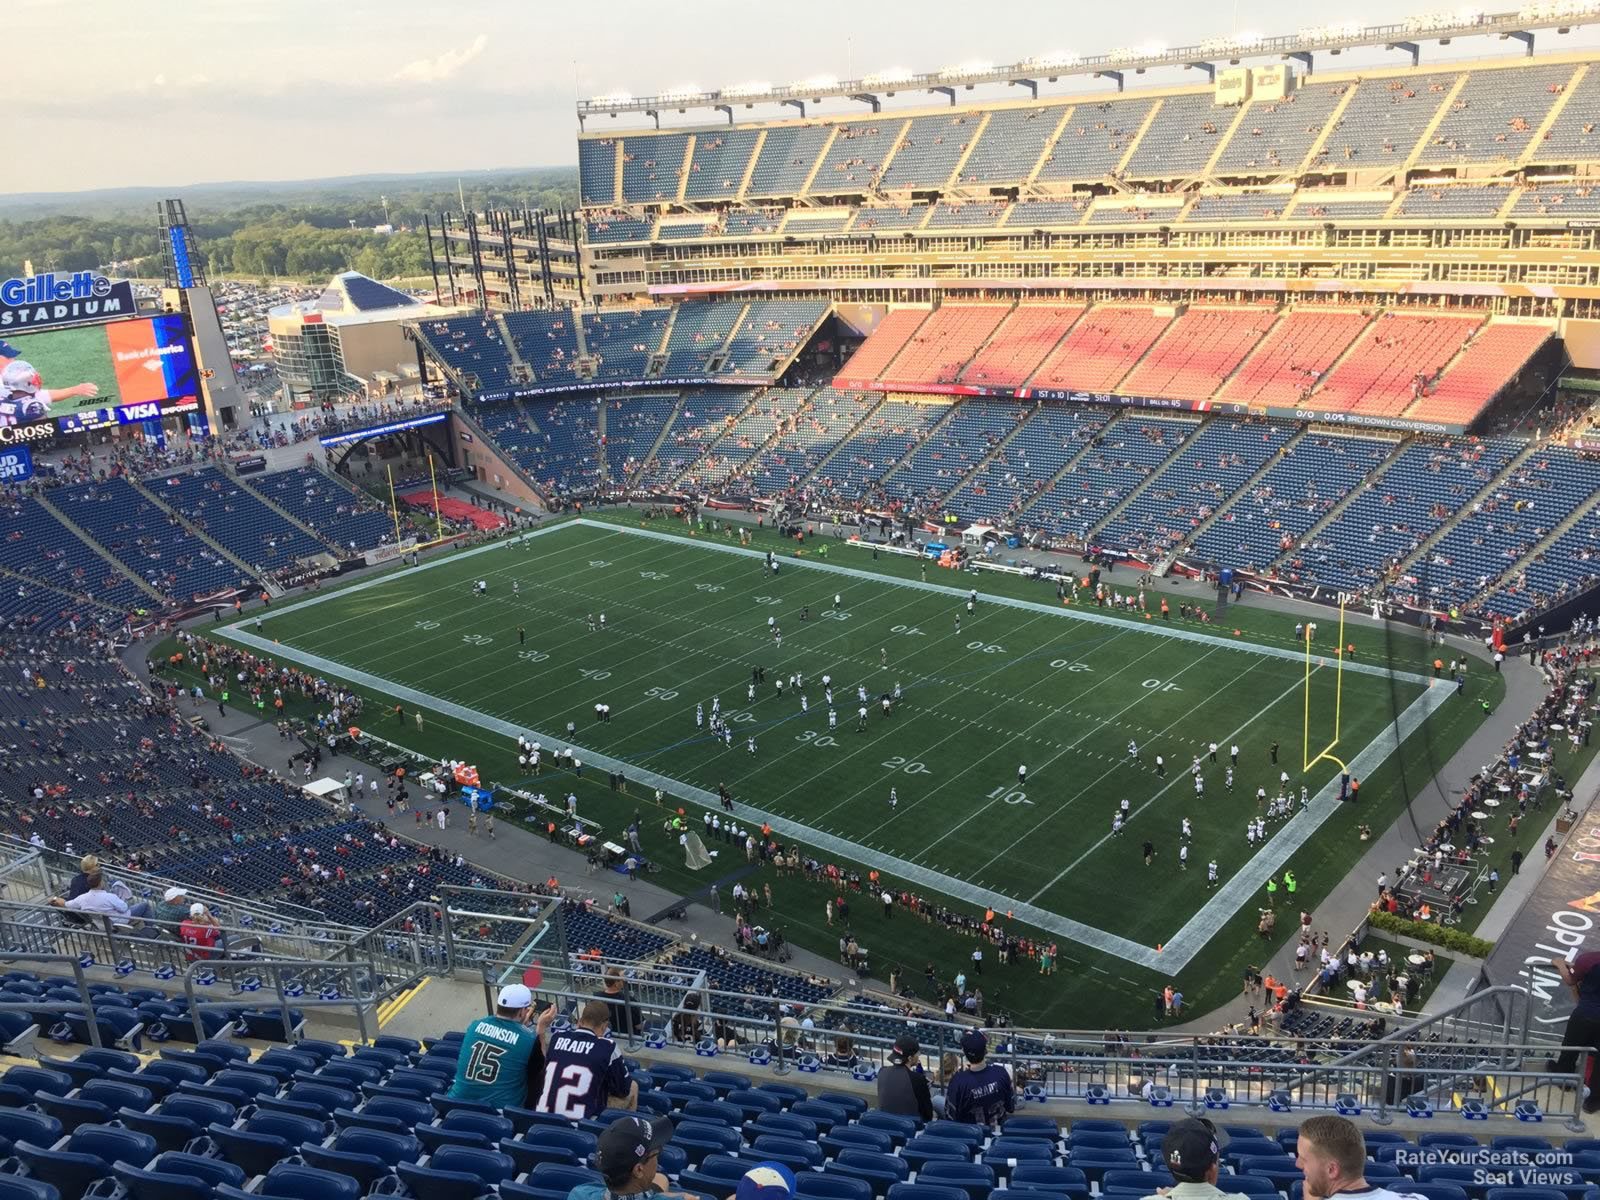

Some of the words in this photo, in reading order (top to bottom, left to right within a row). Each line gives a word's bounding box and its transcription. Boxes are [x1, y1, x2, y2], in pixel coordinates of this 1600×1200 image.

[0, 272, 111, 307] Gillette
[0, 298, 121, 325] STADIUM
[1038, 390, 1049, 398] 1ST
[120, 402, 159, 421] VISA
[160, 402, 199, 416] EMPOWER
[1295, 409, 1315, 418] 0/0
[1324, 412, 1345, 421] 0.0%
[1347, 415, 1363, 423] 3RD
[1364, 417, 1390, 426] DOWN
[1391, 419, 1447, 432] CONVERSION
[643, 686, 680, 701] 50
[794, 730, 836, 747] 30
[880, 756, 926, 775] 20
[985, 786, 1028, 805] 10
[474, 1021, 520, 1046] ROBINSON
[554, 1036, 595, 1055] BRADY
[465, 1040, 508, 1085] 15
[535, 1061, 594, 1120] 12
